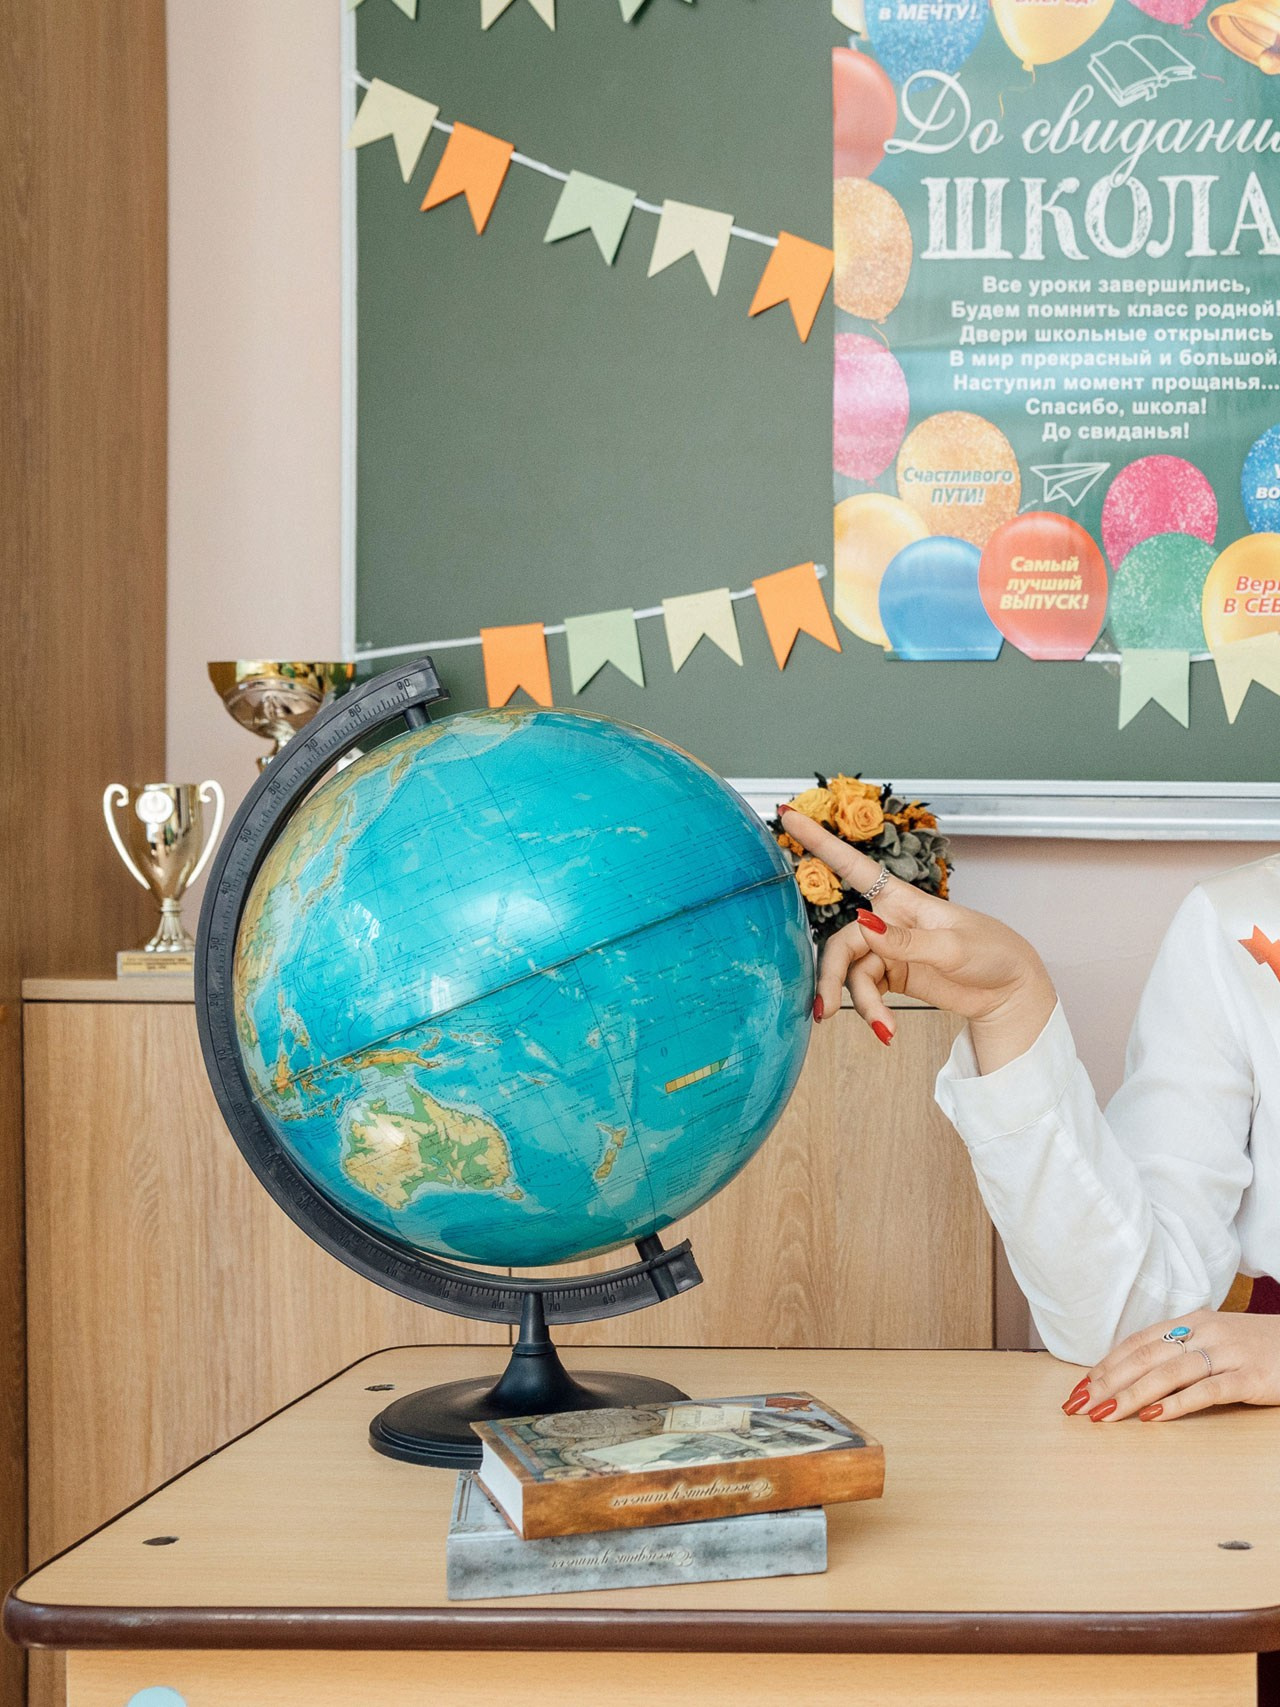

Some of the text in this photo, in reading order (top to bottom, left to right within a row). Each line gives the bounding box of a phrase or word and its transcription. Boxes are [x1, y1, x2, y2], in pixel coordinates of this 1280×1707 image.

[878, 3, 977, 21] в МЕЧТУ!
[882, 69, 1004, 155] До
[982, 276, 1251, 298] Все уроки завершились,
[951, 301, 1020, 321] Будем
[1027, 303, 1121, 319] помнить
[1127, 303, 1189, 318] класс
[959, 326, 1274, 346] Двери школьные открылись
[950, 351, 964, 367] В
[972, 353, 1014, 371] мир
[1021, 350, 1152, 371] прекрасный
[1160, 353, 1172, 366] и
[953, 374, 1280, 395] Наступил момент прощанья...
[1025, 398, 1207, 418] Спасибо, школа!
[1042, 423, 1190, 443] До свиданья!
[902, 465, 1016, 486] Счастливого
[931, 486, 986, 506] ПУТИ!
[1010, 554, 1080, 574] Самый
[1005, 574, 1083, 595] лучший
[1000, 592, 1090, 611] ВЫПУСК!
[1223, 596, 1237, 615] В
[612, 1482, 683, 1508] учителя
[550, 1547, 612, 1570] учителя
